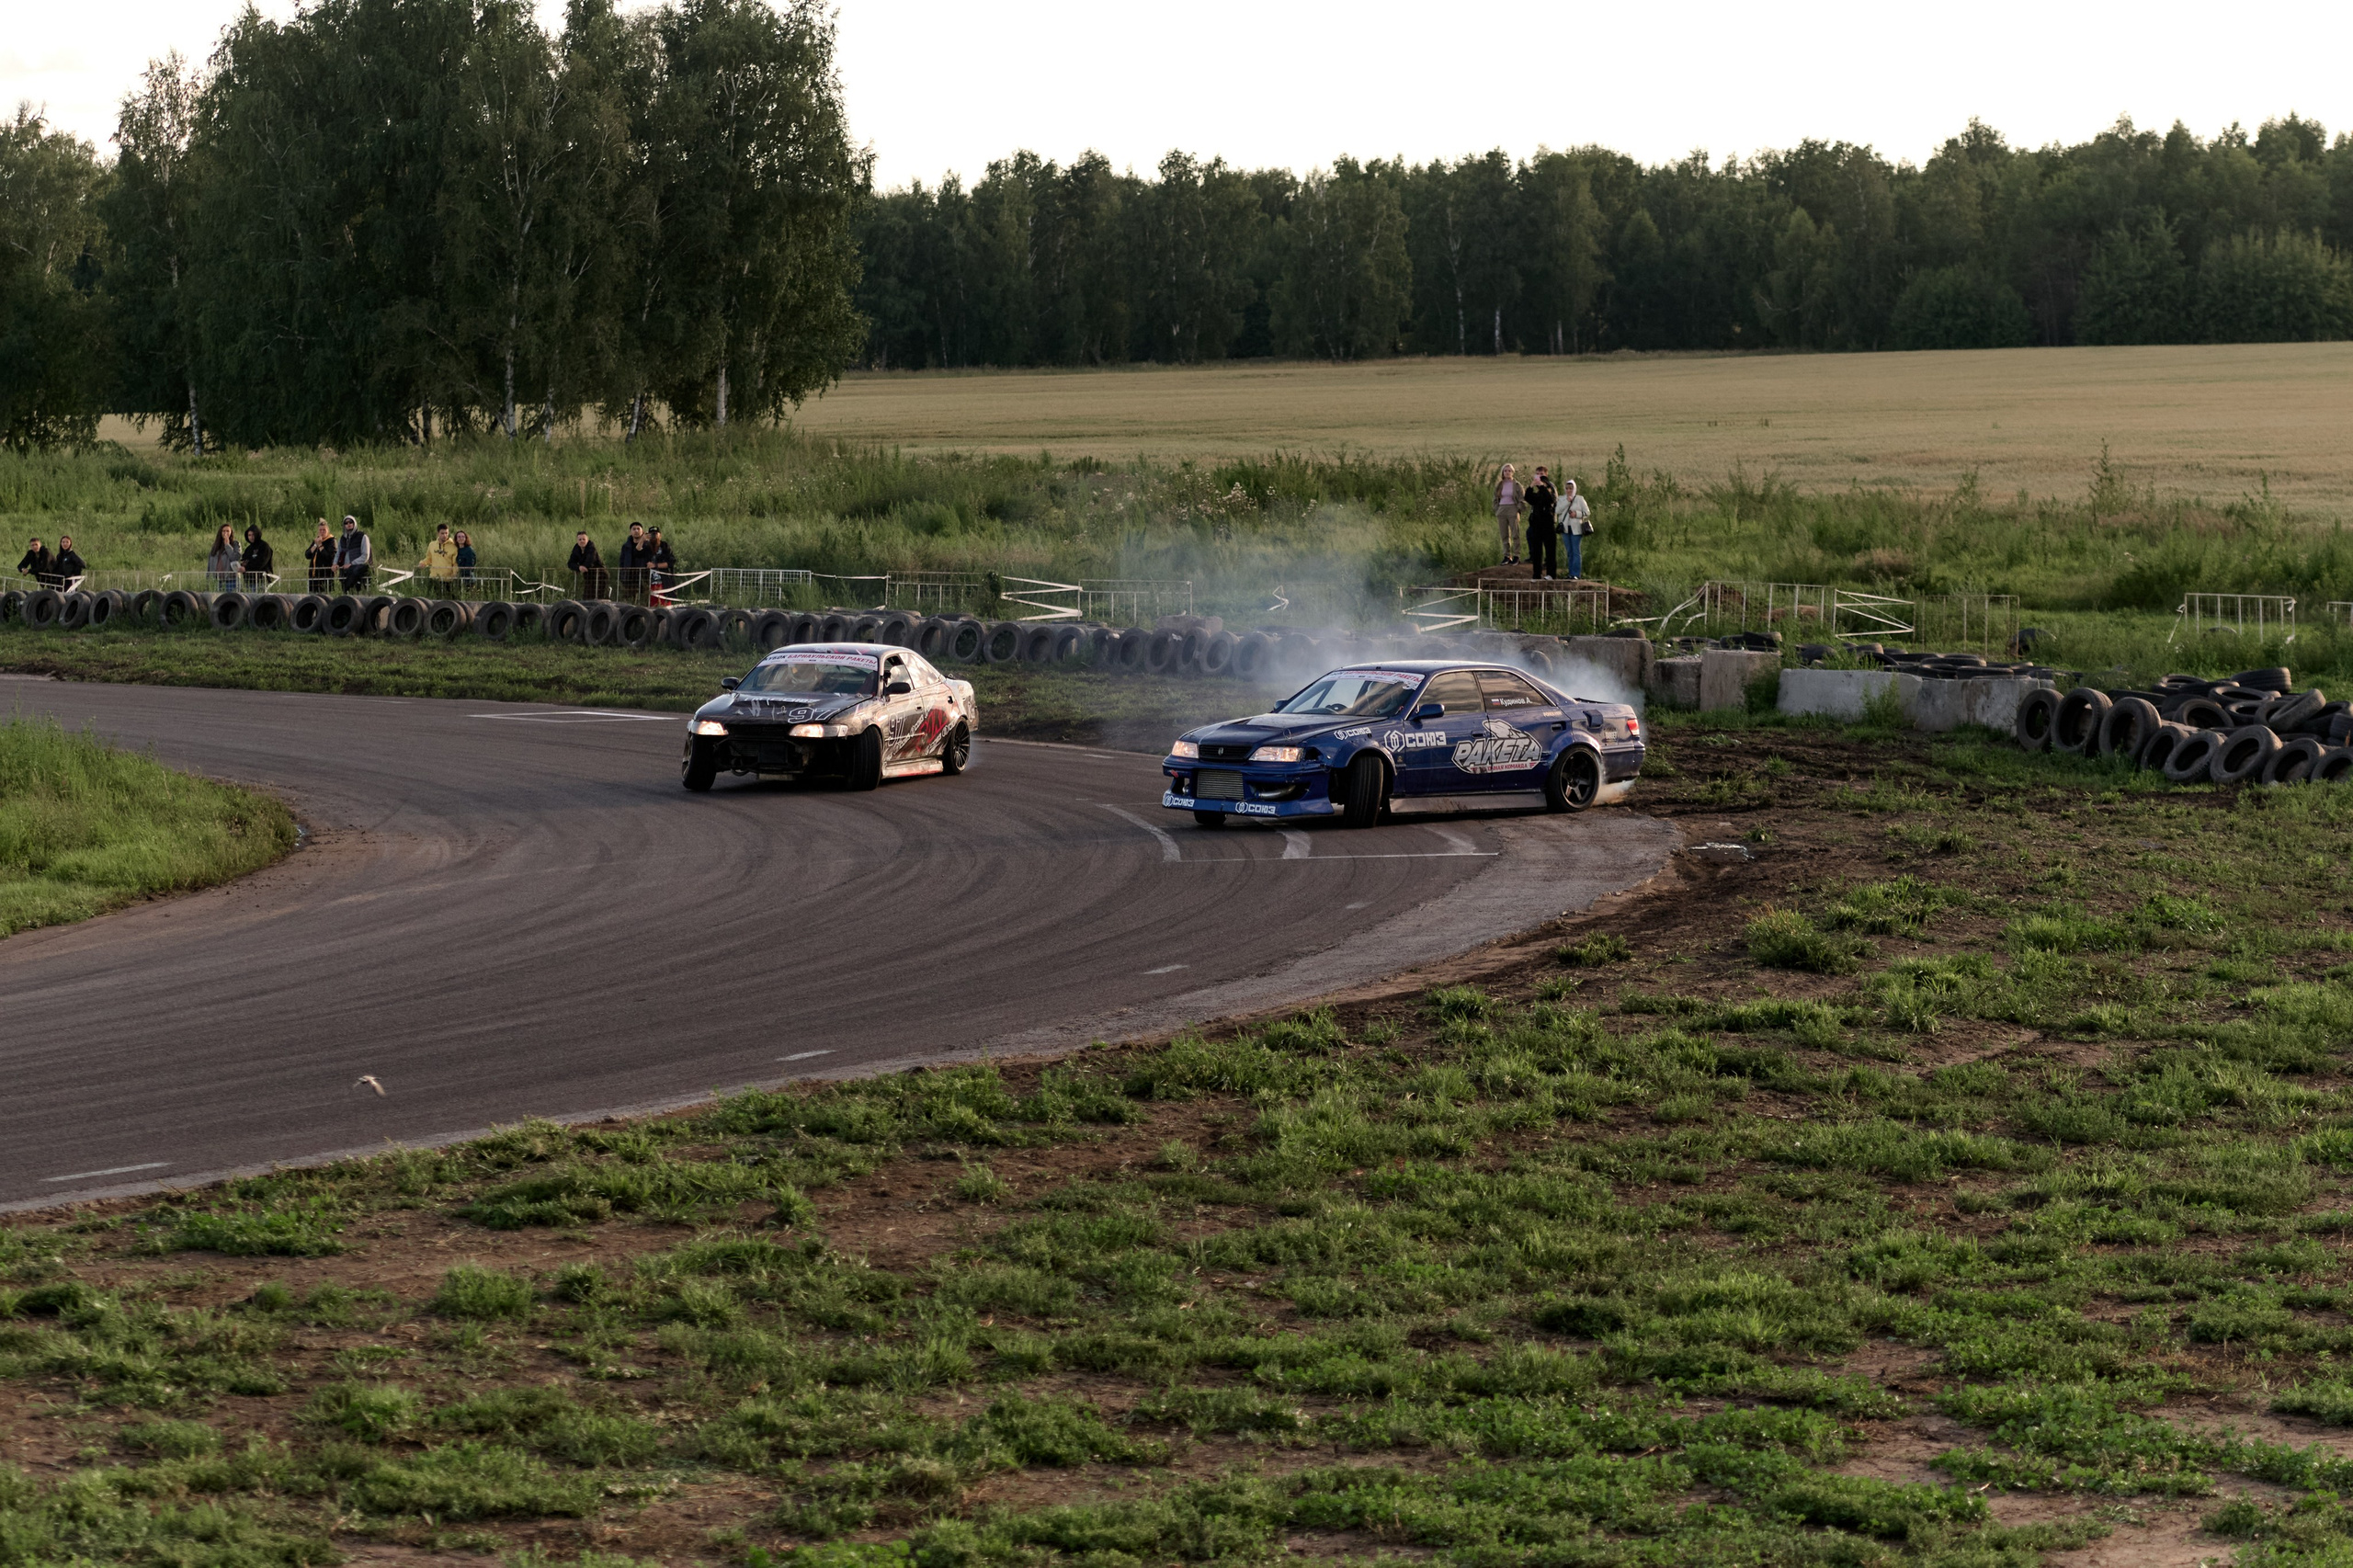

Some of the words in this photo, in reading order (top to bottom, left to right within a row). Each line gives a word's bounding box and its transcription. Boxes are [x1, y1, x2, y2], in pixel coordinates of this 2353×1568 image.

[846, 656, 877, 665] РАКЕТЫ
[1499, 698, 1526, 707] Кудинов
[787, 706, 841, 724] 97
[1347, 726, 1371, 737] СОЮЗ
[1404, 731, 1447, 748] СОЮЗ
[1452, 738, 1540, 768] РАКЕТА
[1172, 798, 1195, 808] СОЮЗ
[1247, 805, 1276, 814] СОЮЗ
